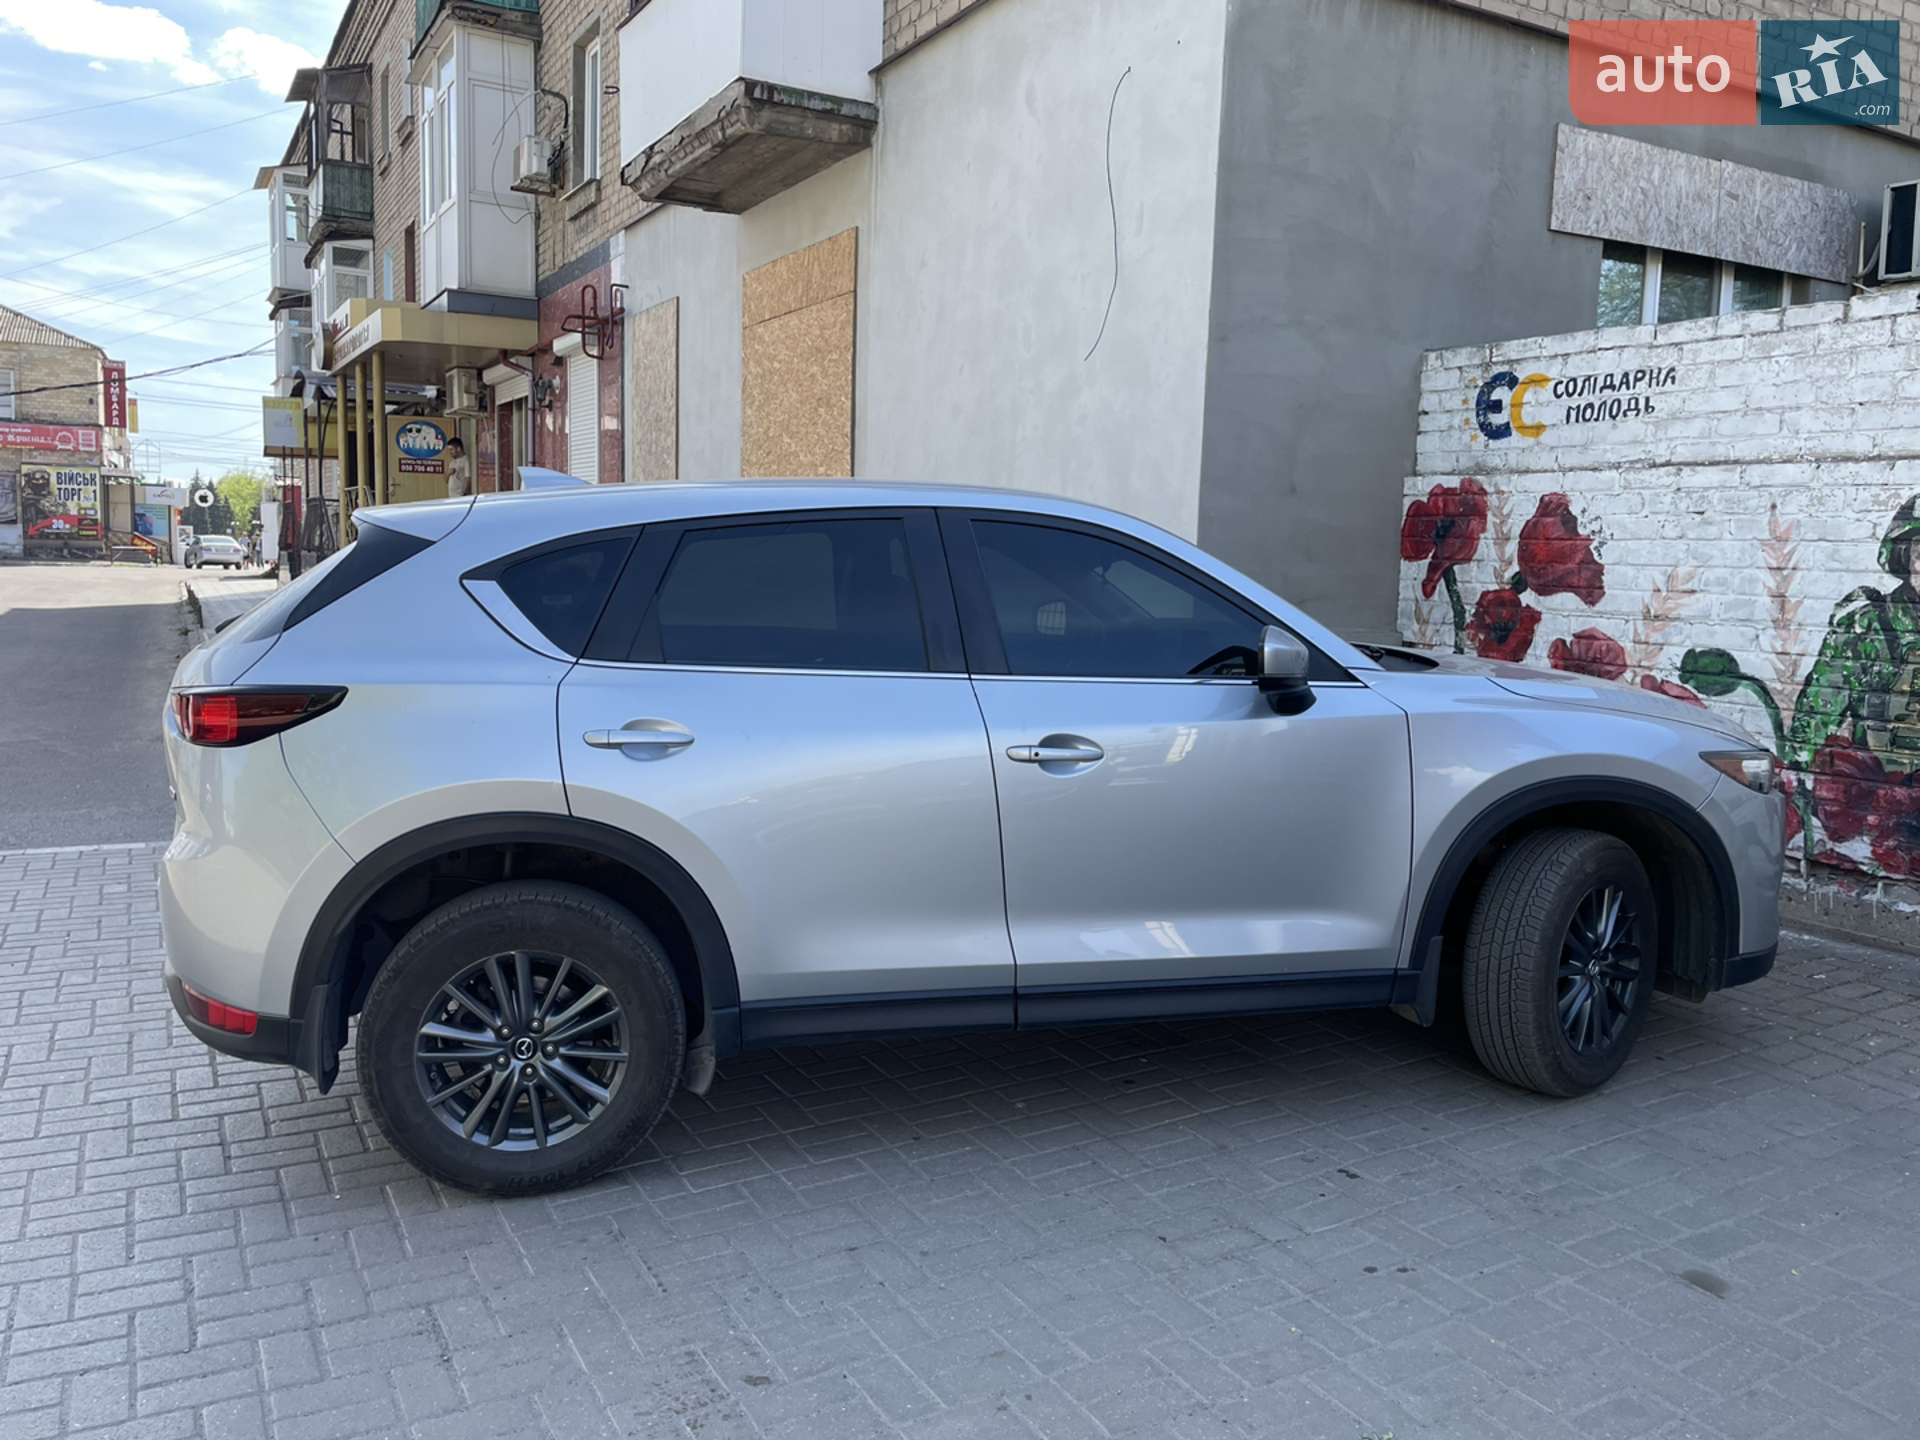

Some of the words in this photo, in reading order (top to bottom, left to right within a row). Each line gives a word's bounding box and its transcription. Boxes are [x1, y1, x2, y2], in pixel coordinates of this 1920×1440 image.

[1552, 366, 1677, 400] СОЛІДАРНА
[1565, 396, 1656, 425] МОЛОДЬ
[56, 469, 97, 487] ВІЙСЬК
[56, 487, 82, 502] ТОРГ
[52, 519, 64, 529] 30
